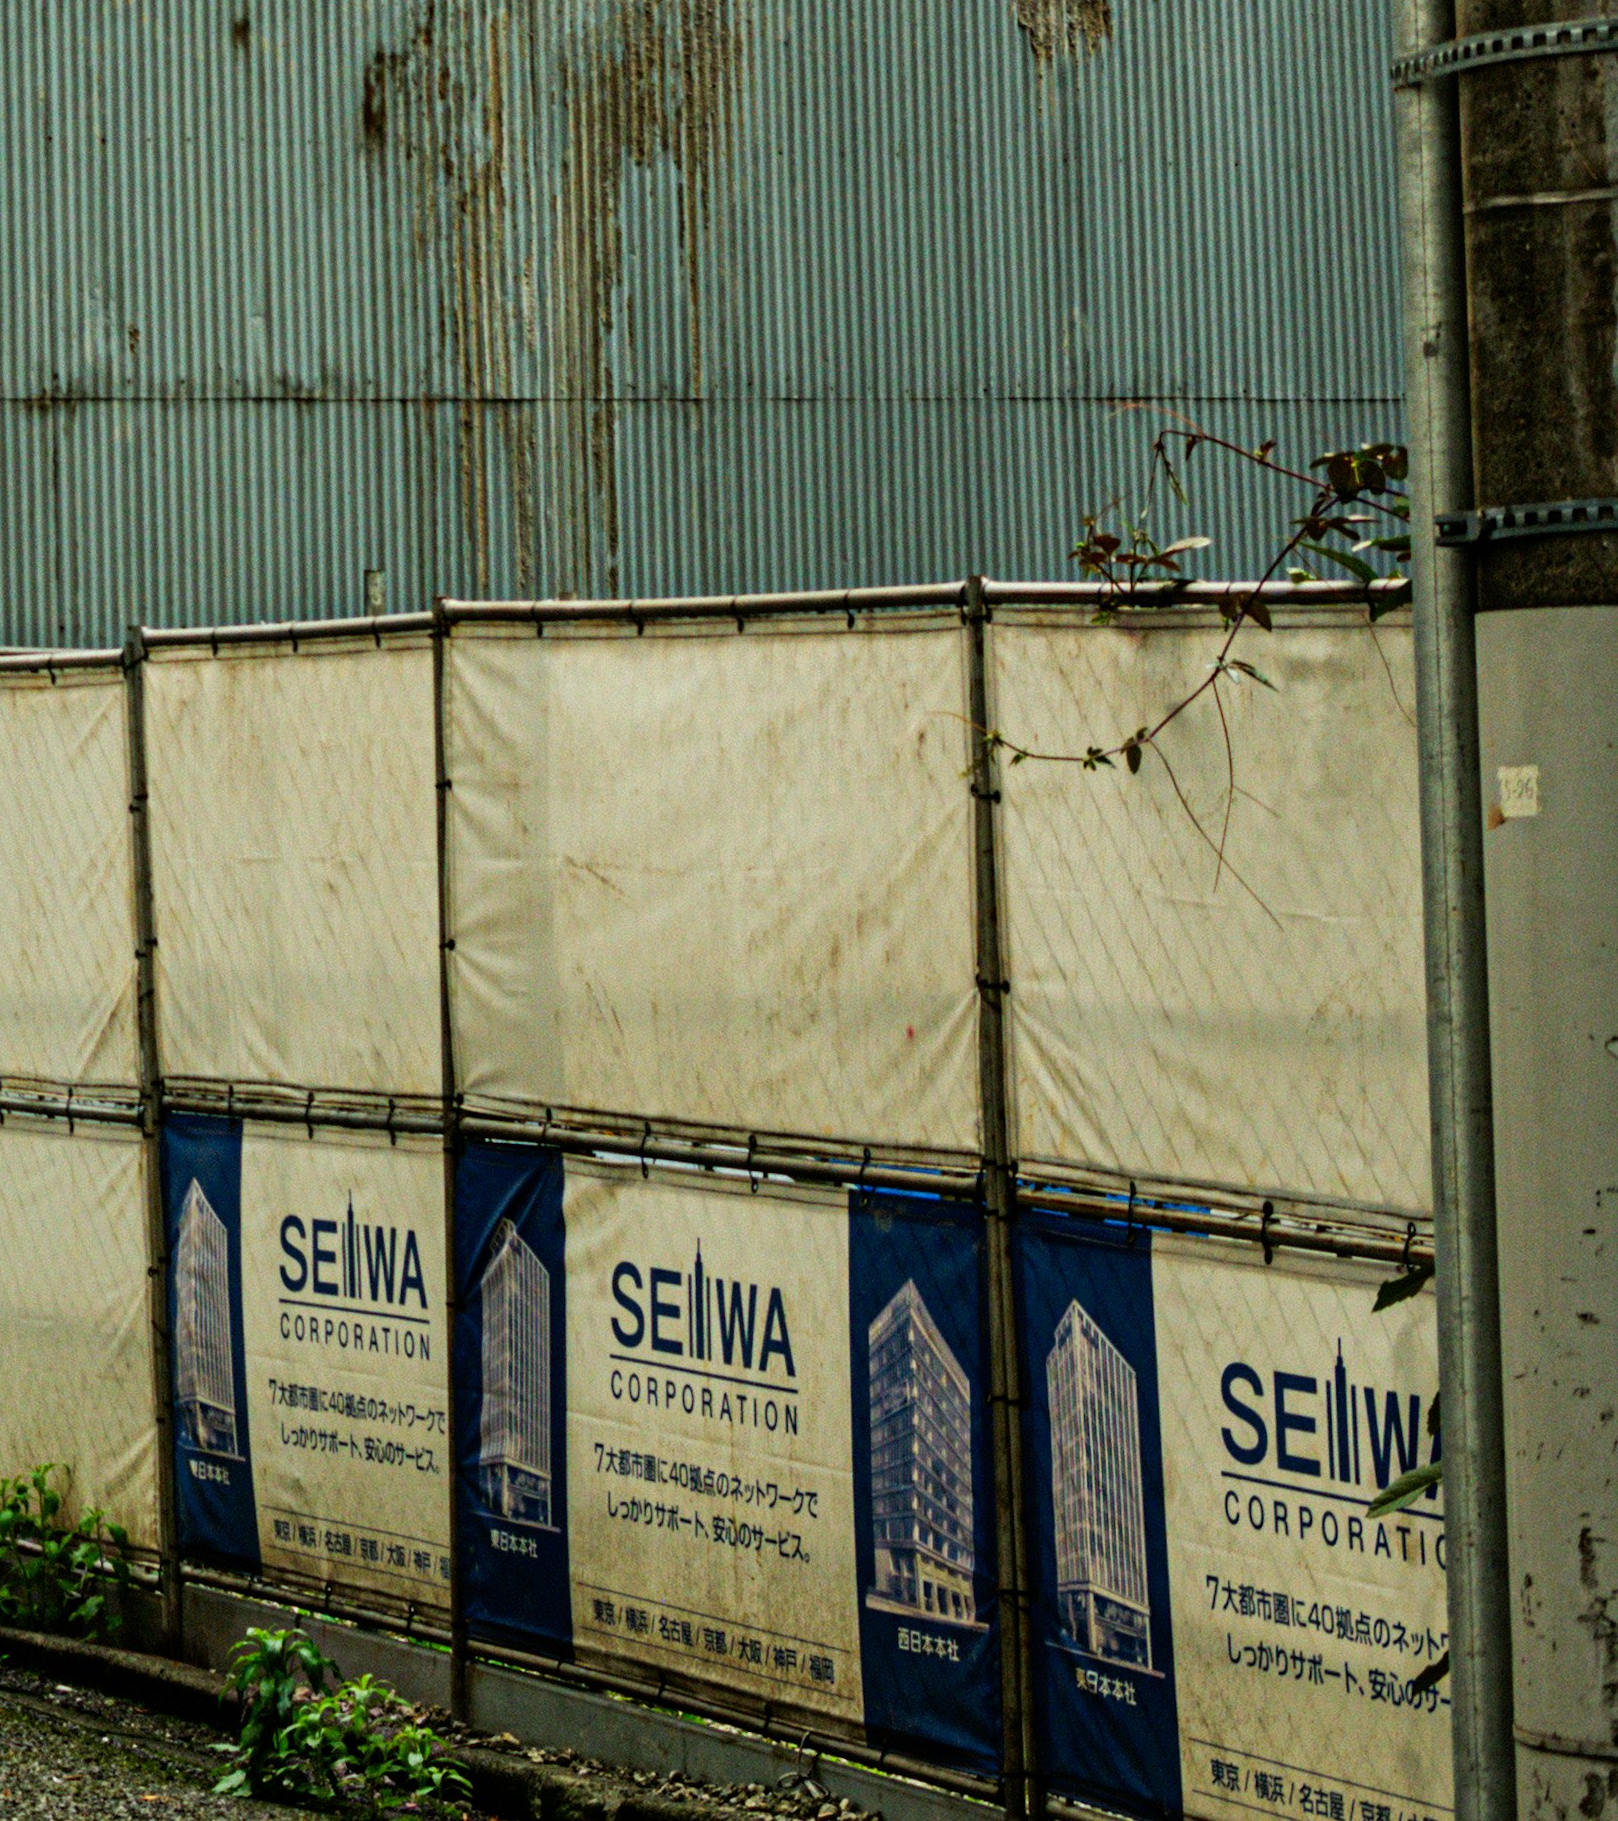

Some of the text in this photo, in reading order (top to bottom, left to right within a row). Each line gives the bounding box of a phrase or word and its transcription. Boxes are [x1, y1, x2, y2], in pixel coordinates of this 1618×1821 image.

[279, 1189, 428, 1309] SEIWA
[280, 1312, 430, 1361] CORPORATION
[610, 1237, 796, 1378] SEIWA
[611, 1370, 798, 1436] CORPORATION
[594, 1443, 818, 1518] 7大都市圏に40拠点のネットワークで
[490, 1529, 539, 1559] 東日本本社
[607, 1491, 811, 1563] しっかりサポート、安心のサービス。
[1224, 1490, 1446, 1572] CORPORATIO
[658, 1614, 694, 1647] 名古屋
[897, 1626, 960, 1662] 西日本本社
[1075, 1667, 1137, 1706] 東日本本社
[1210, 1758, 1241, 1793] 東京
[1254, 1769, 1285, 1805] 横浜
[1299, 1783, 1345, 1821] 名古屋
